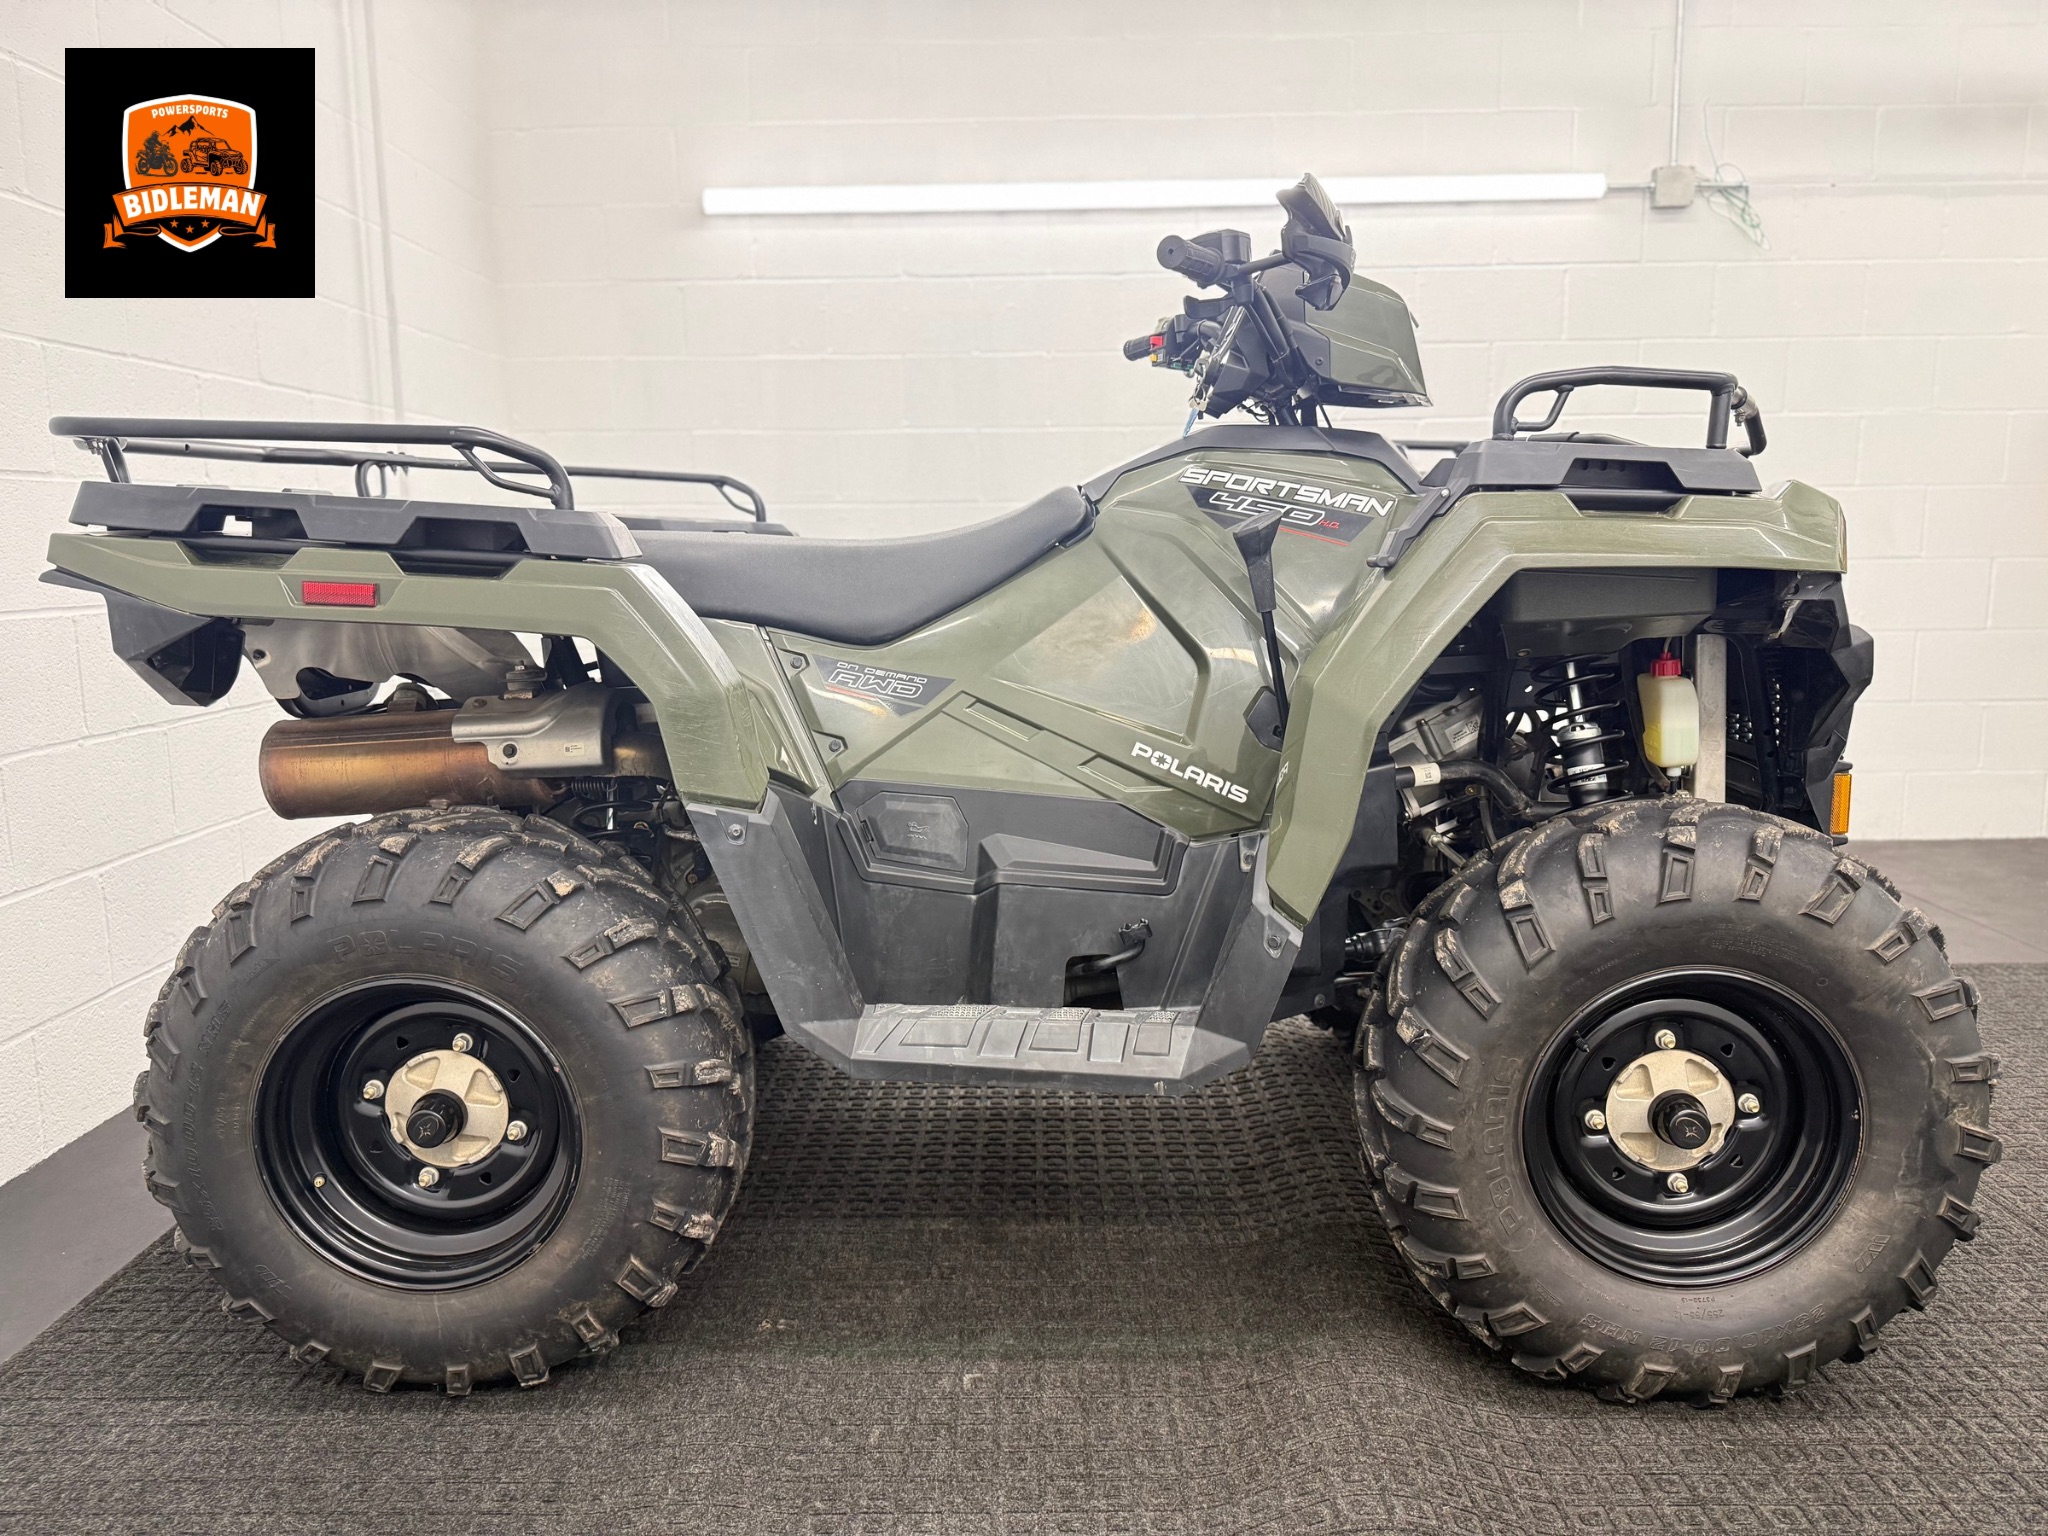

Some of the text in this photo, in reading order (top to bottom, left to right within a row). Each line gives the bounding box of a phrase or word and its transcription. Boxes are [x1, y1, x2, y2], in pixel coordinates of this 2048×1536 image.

[1179, 468, 1394, 517] SPORTSMAN
[828, 669, 923, 698] AWD
[836, 661, 928, 684] ON DEMAND
[1131, 741, 1249, 804] POLARIS
[326, 929, 524, 985] POLARIS
[1483, 1055, 1525, 1236] POLARIS
[1579, 1312, 1642, 1344] NHS
